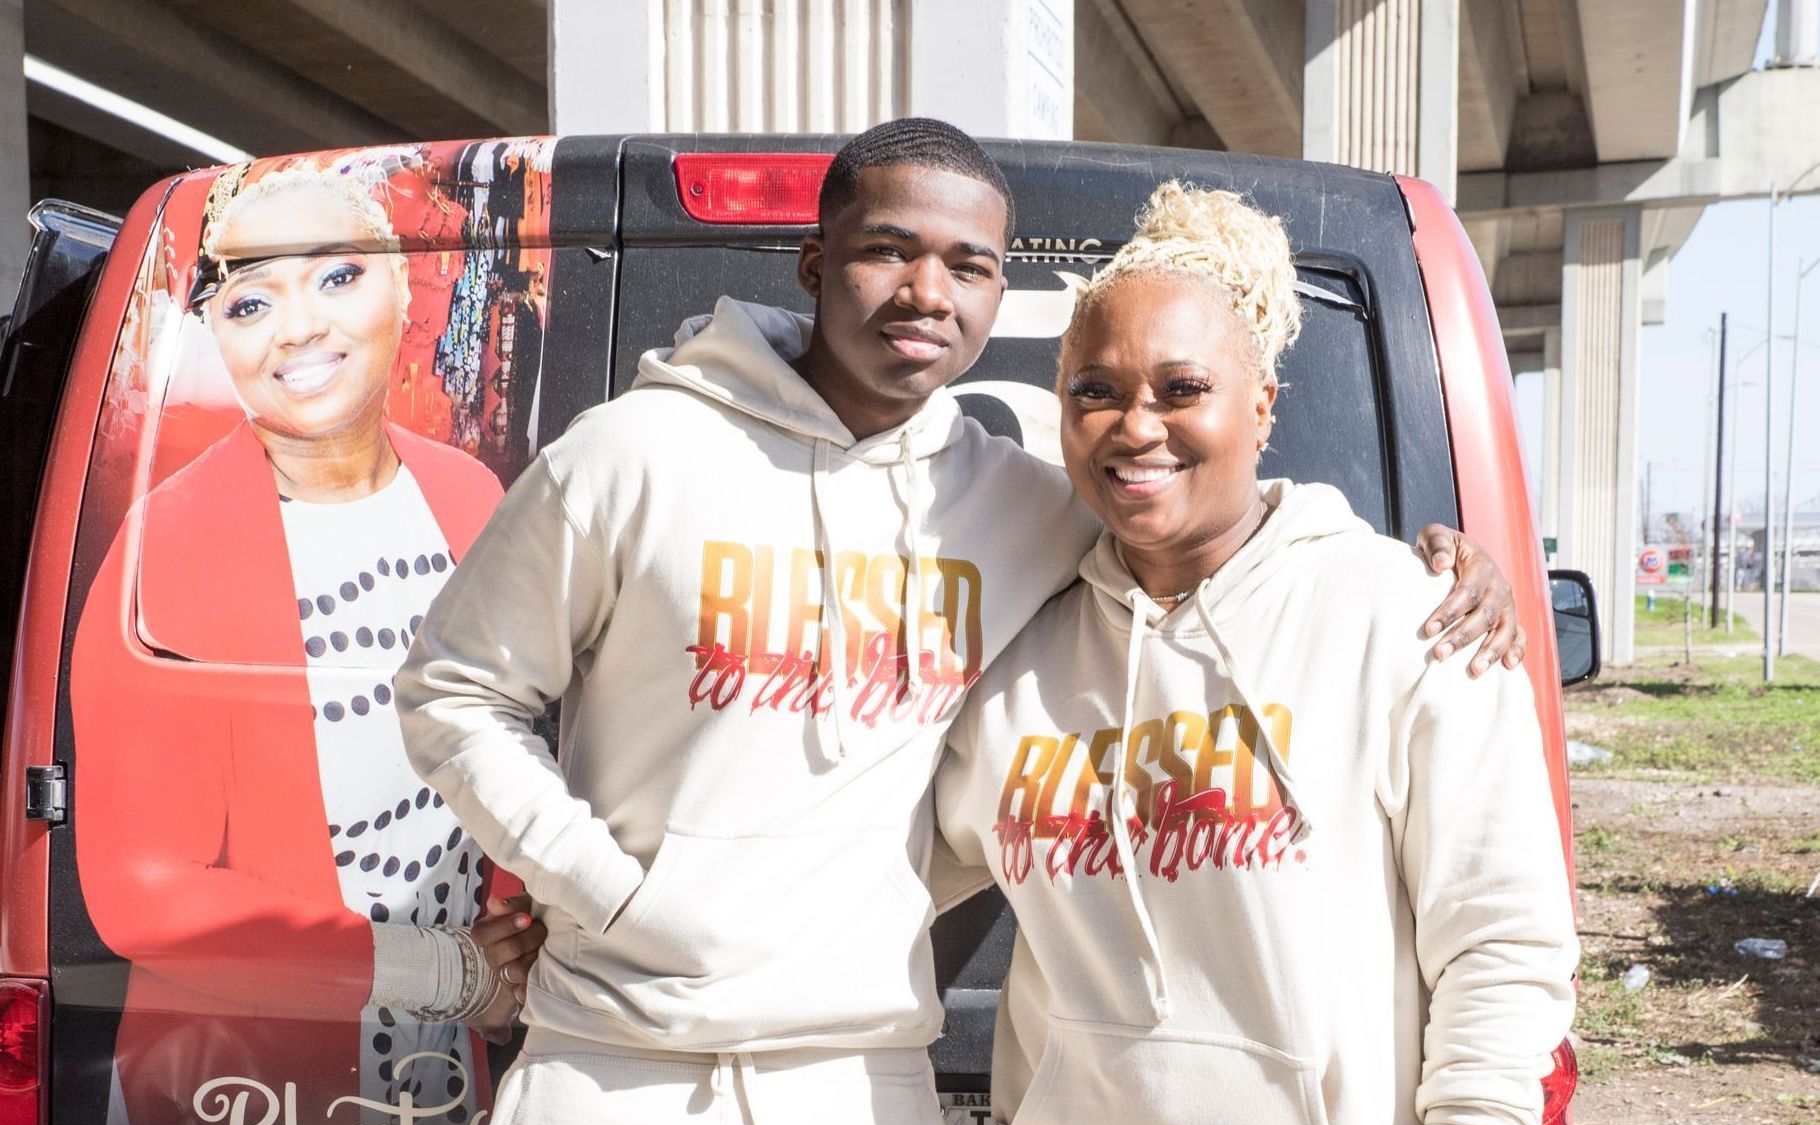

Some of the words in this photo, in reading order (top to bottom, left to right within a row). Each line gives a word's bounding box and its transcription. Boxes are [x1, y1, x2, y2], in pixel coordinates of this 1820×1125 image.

[697, 540, 984, 687] BLESSED
[685, 643, 748, 710] to
[997, 703, 1293, 839] BLESSED
[992, 815, 1034, 891] to
